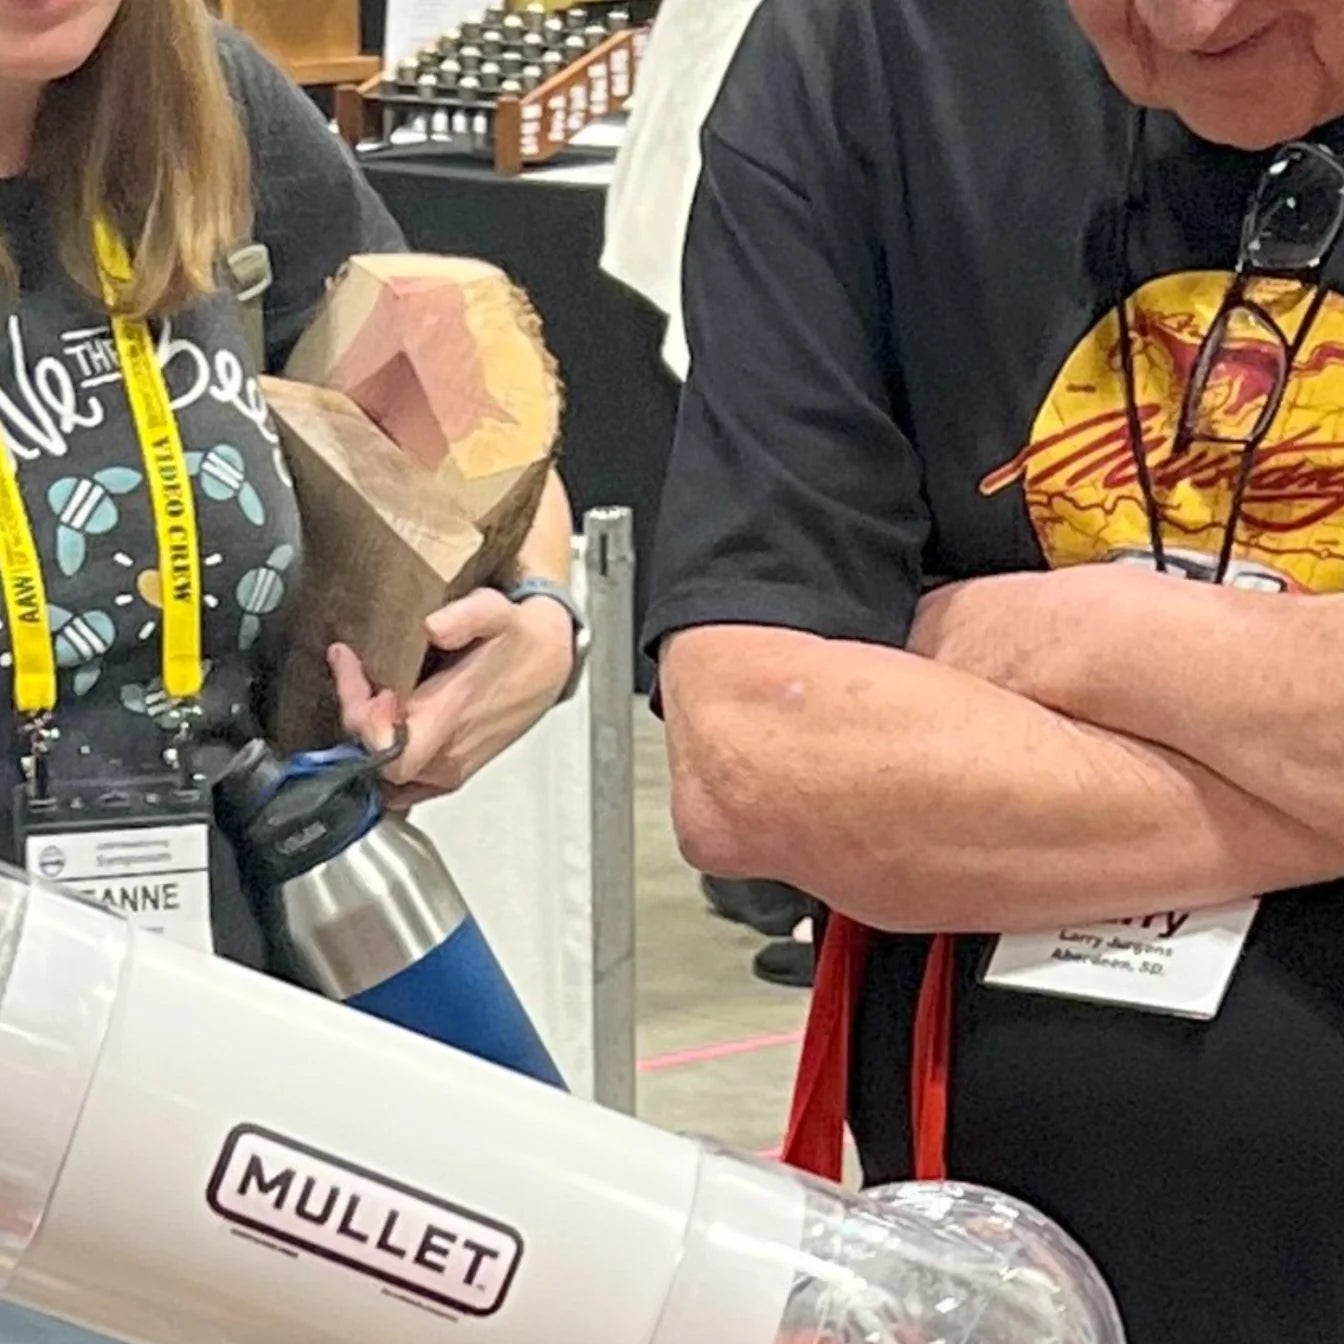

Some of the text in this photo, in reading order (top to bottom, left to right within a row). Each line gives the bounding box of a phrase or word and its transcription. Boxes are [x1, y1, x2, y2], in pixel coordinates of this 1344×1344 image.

[152, 434, 194, 602] VIDEO CREW
[10, 575, 41, 624] AAW
[81, 881, 180, 912] ANNE
[236, 1152, 500, 1287] MULLET
